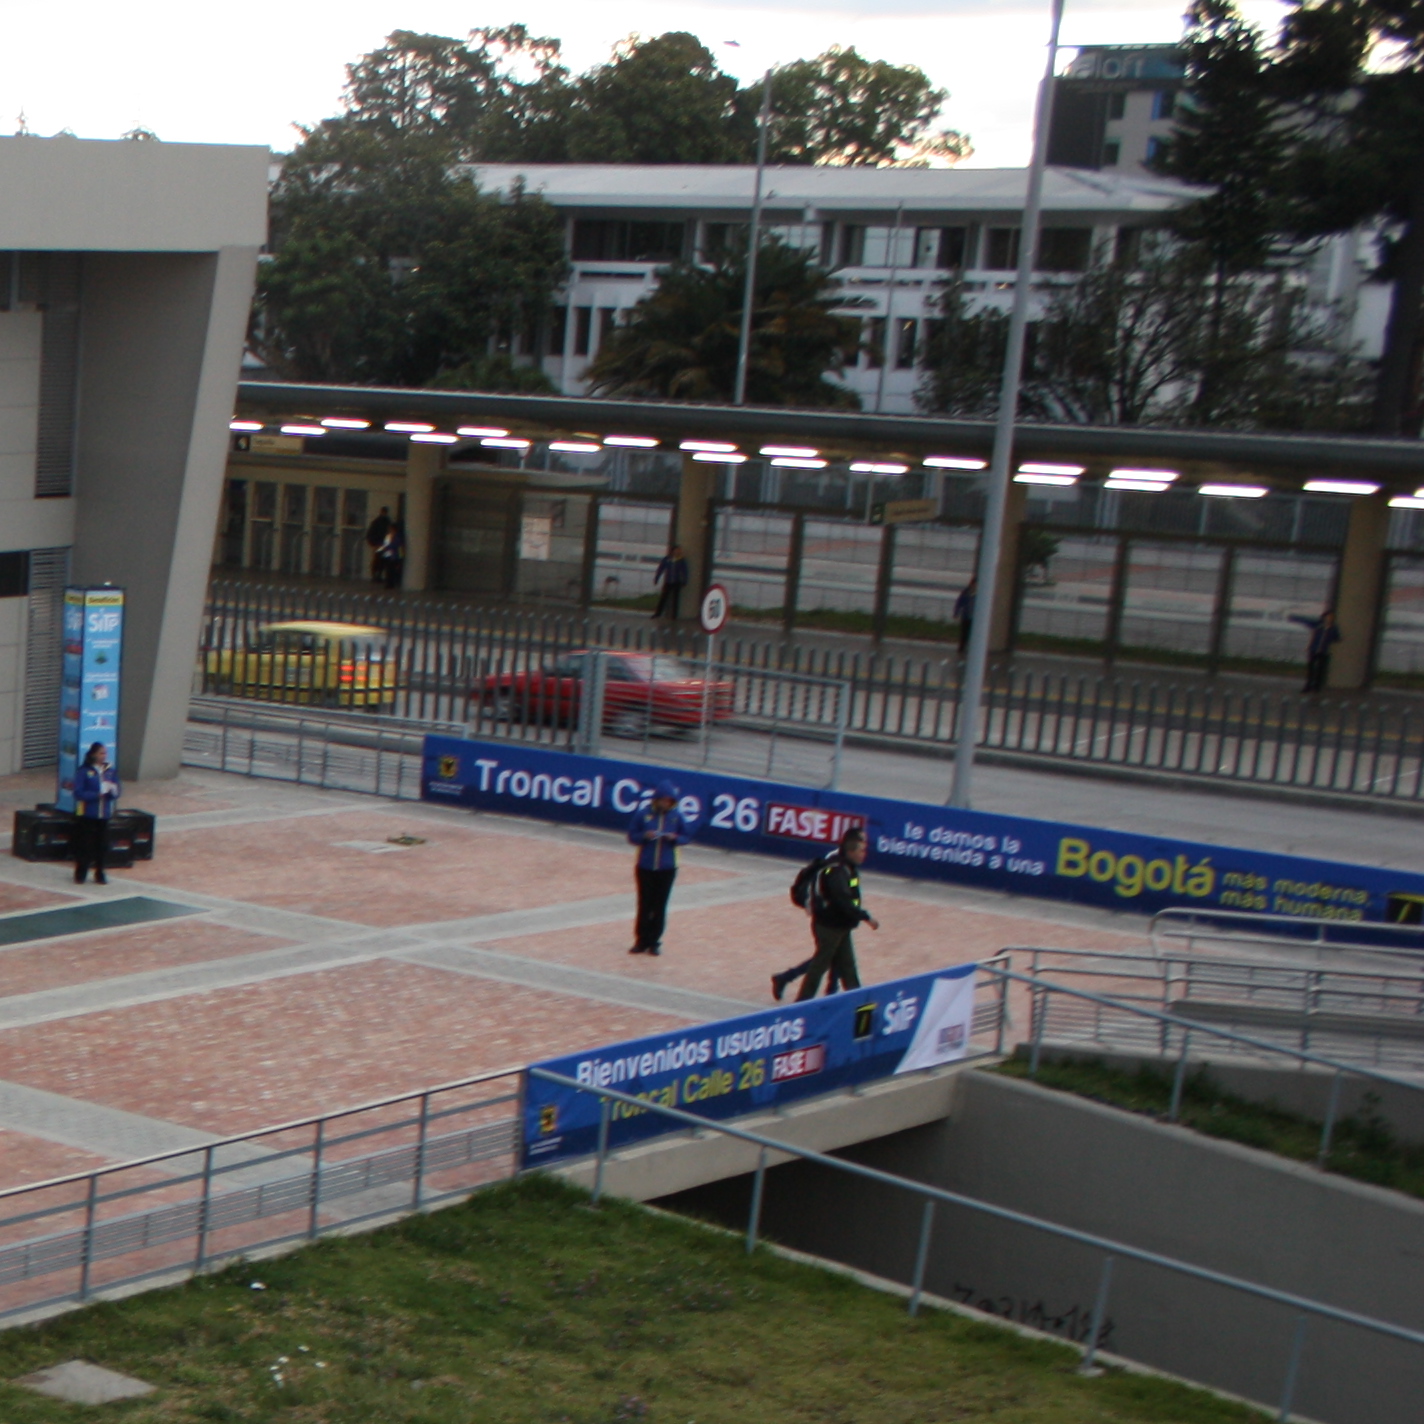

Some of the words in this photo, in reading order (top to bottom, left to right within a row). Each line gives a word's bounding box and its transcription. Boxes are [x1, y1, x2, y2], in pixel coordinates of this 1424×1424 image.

[475, 759, 603, 808] Troncal
[612, 778, 701, 823] Cae
[710, 794, 760, 832] 26
[768, 806, 830, 839] FASE
[876, 835, 985, 868] bienvenida
[988, 854, 1003, 870] a
[1006, 857, 1046, 876] una
[928, 826, 997, 851] damos
[1002, 835, 1021, 855] la
[1055, 837, 1215, 898] Bogotá
[1222, 870, 1268, 892] más
[1219, 889, 1268, 911] más
[576, 1038, 712, 1094] Bienvenidos
[715, 1017, 806, 1059] usuarios
[682, 1068, 736, 1104] Calle
[738, 1058, 768, 1091] 26
